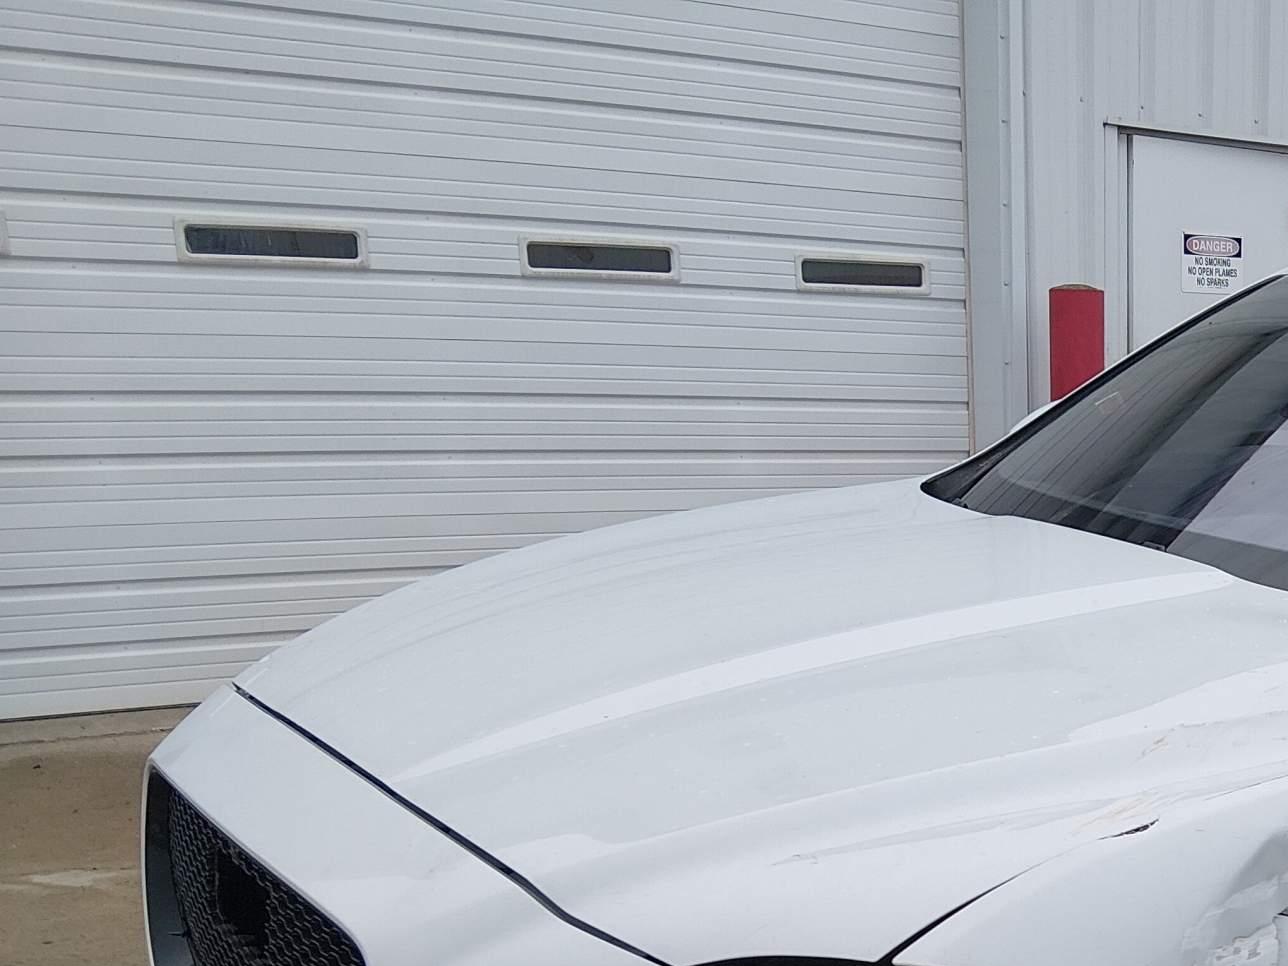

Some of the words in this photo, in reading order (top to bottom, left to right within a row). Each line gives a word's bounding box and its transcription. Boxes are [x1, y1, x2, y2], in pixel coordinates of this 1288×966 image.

[1192, 239, 1233, 253] DANGER
[1194, 257, 1203, 266] NO
[1205, 257, 1231, 267] SMOKING
[1188, 266, 1196, 275] NO
[1198, 267, 1213, 276] OPEN
[1215, 268, 1237, 278] FLAMES
[1197, 277, 1205, 286] NO
[1206, 278, 1229, 287] SPARKS
